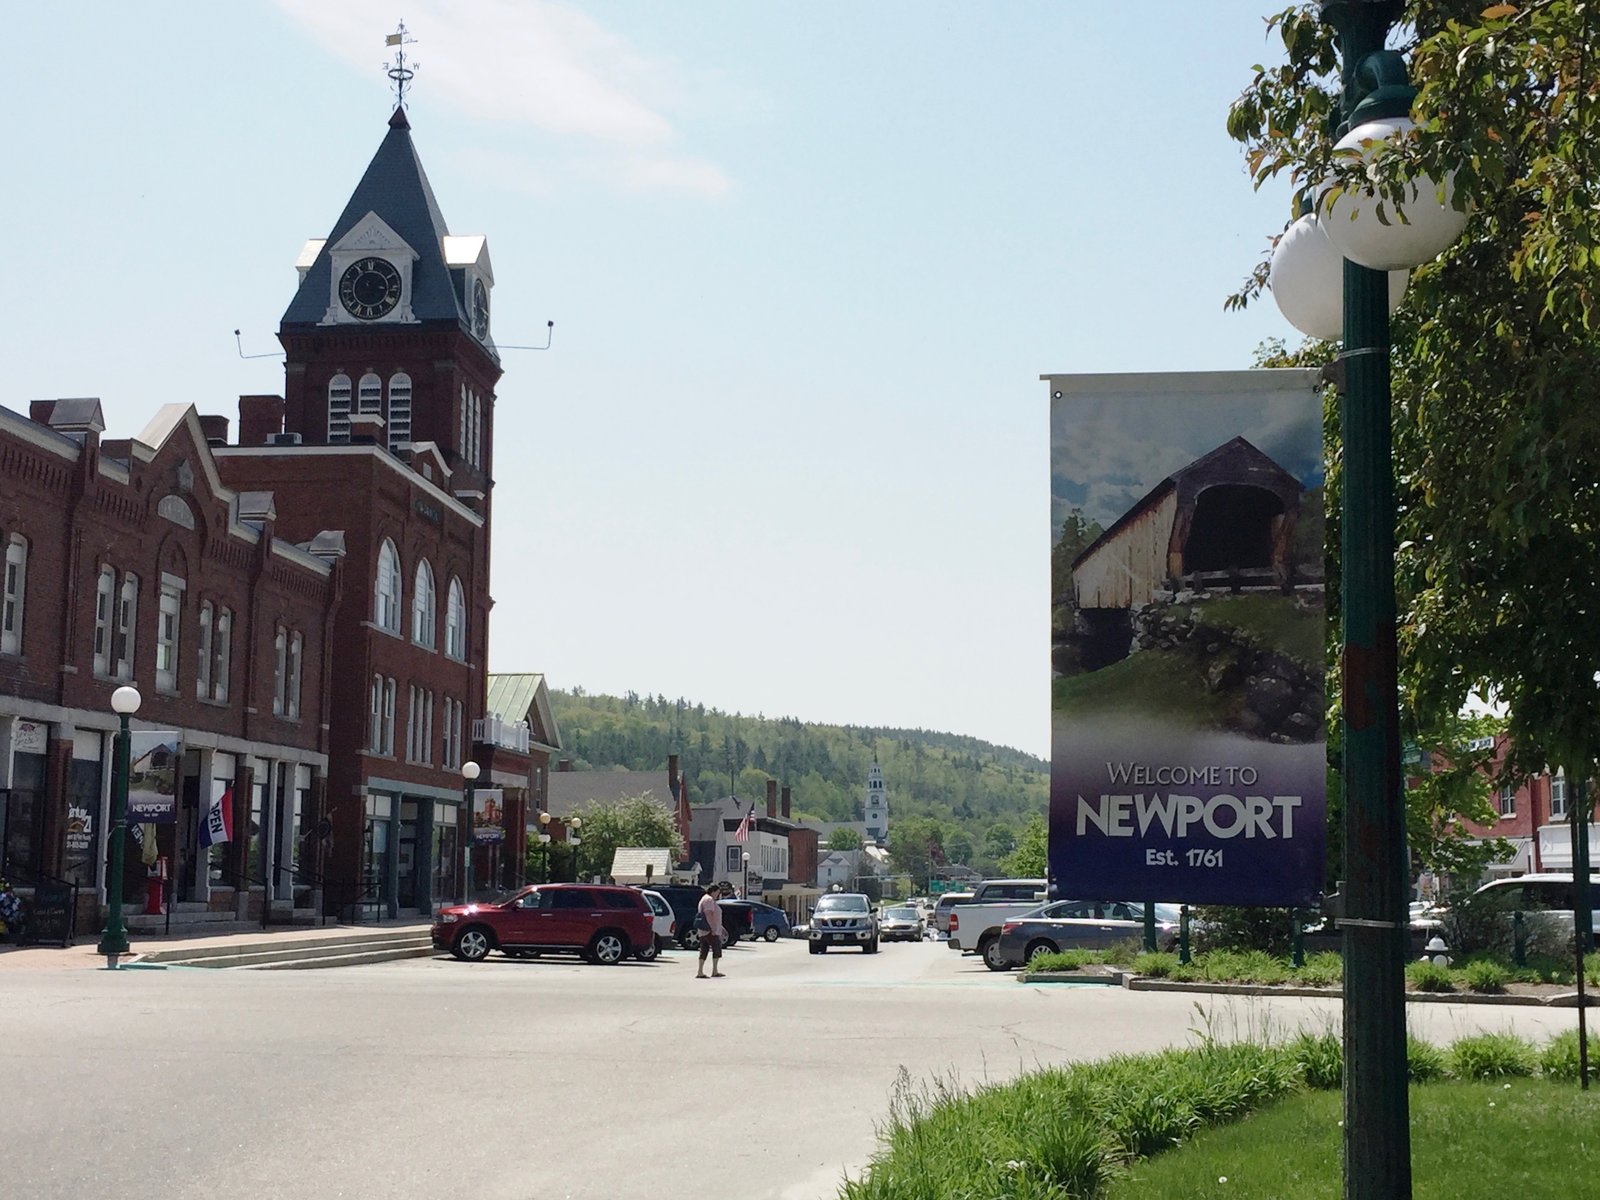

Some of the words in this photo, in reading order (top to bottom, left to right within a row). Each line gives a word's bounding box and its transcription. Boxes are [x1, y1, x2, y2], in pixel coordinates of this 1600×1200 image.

[1226, 766, 1258, 785] TO
[132, 803, 171, 813] NEWPORT
[1076, 792, 1302, 839] NEWPORT
[1146, 849, 1179, 867] Est.
[1186, 849, 1224, 867] 1761
